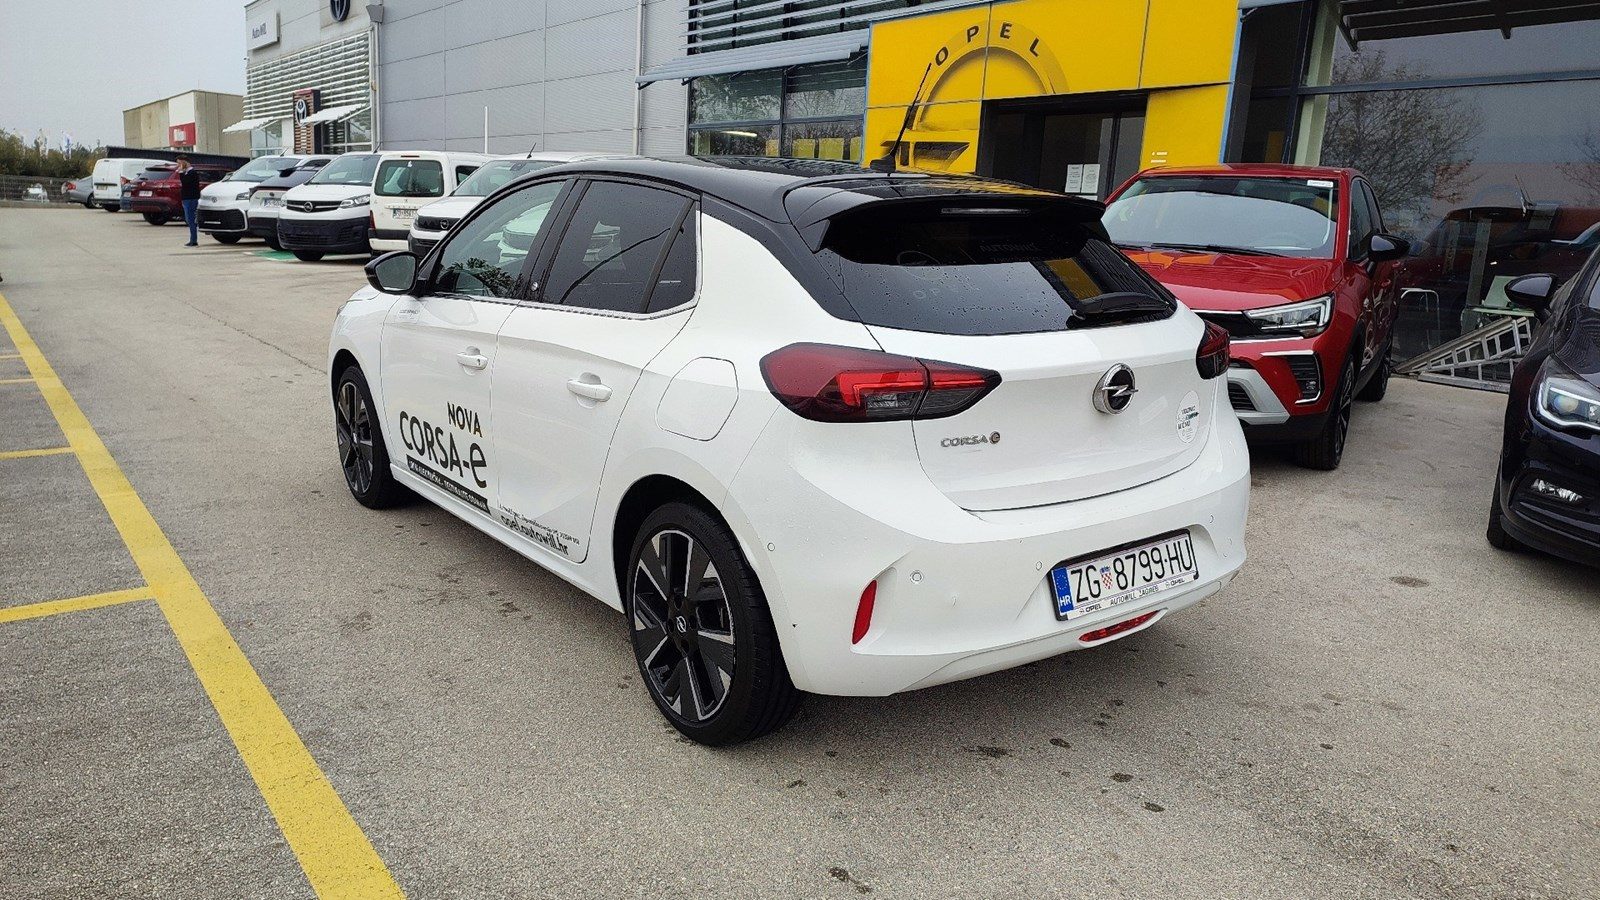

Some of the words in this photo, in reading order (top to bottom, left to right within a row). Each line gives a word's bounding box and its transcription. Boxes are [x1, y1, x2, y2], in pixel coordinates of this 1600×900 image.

[935, 21, 1041, 67] OPEL
[447, 401, 483, 438] NOVA
[400, 410, 488, 489] CORSA-e
[940, 434, 988, 448] CORSA
[1059, 594, 1073, 607] HR
[1070, 564, 1101, 603] ZG
[1085, 603, 1102, 613] OPEL
[1110, 592, 1137, 606] AUTOWILL
